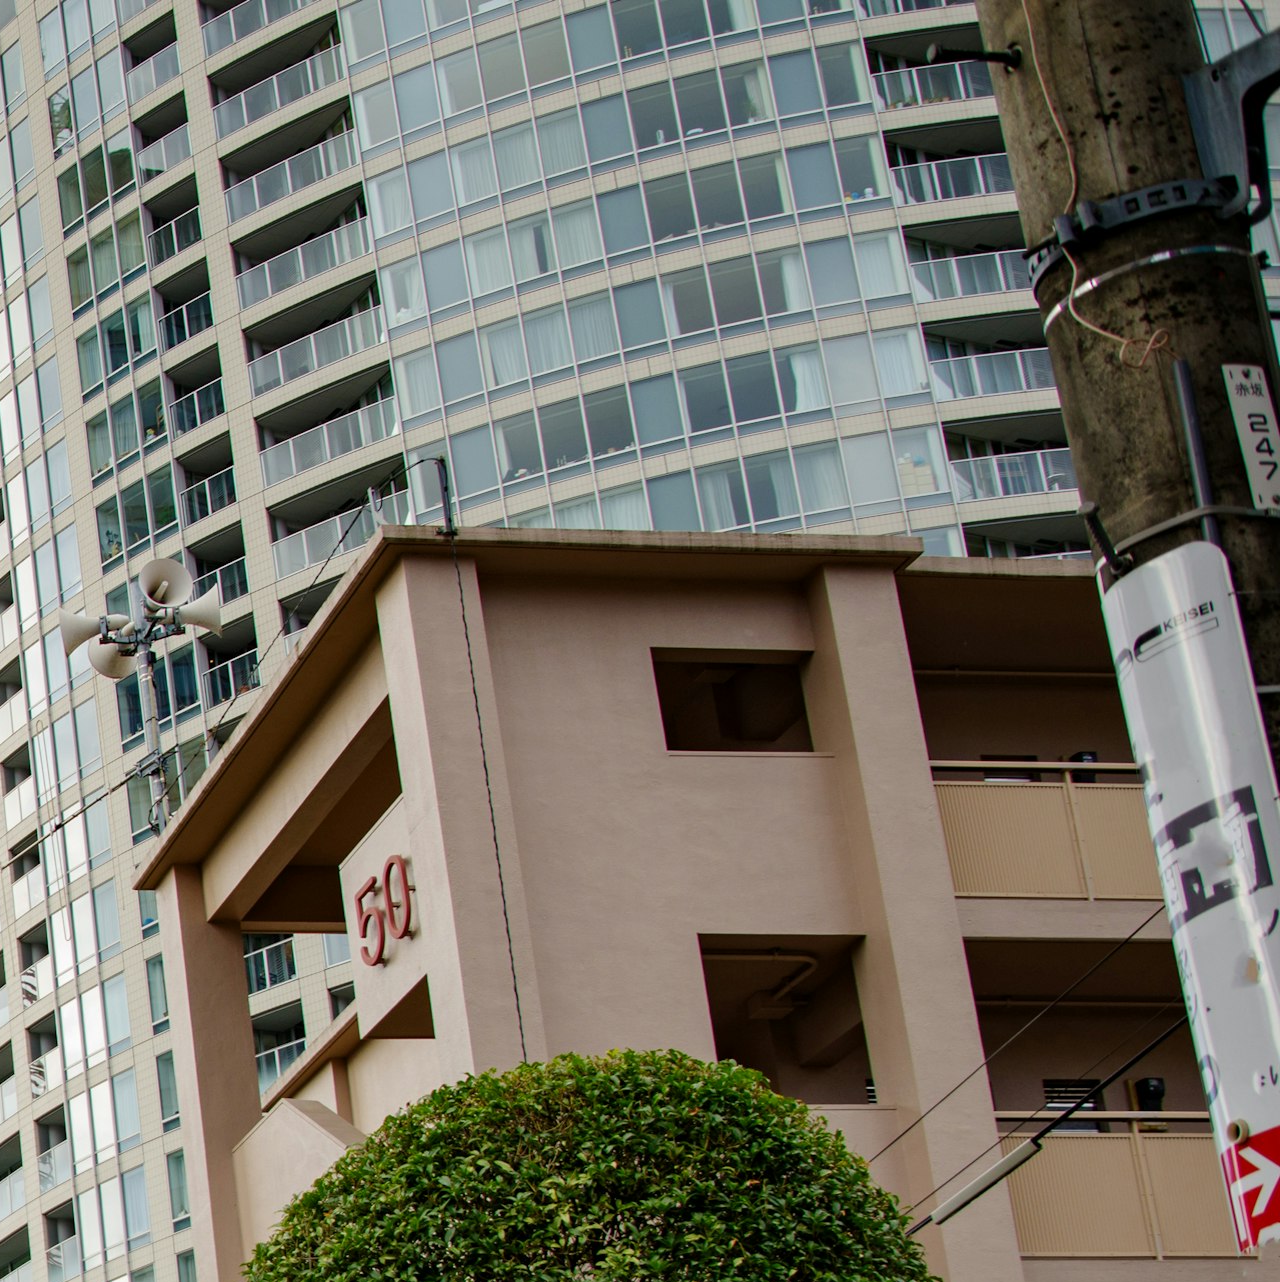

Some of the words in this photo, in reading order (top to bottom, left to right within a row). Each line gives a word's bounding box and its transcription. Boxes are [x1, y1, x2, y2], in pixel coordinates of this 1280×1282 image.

[1235, 382, 1264, 397] 赤坂
[1248, 413, 1279, 481] 247
[1163, 600, 1215, 633] KEISEI
[353, 854, 412, 967] 50
